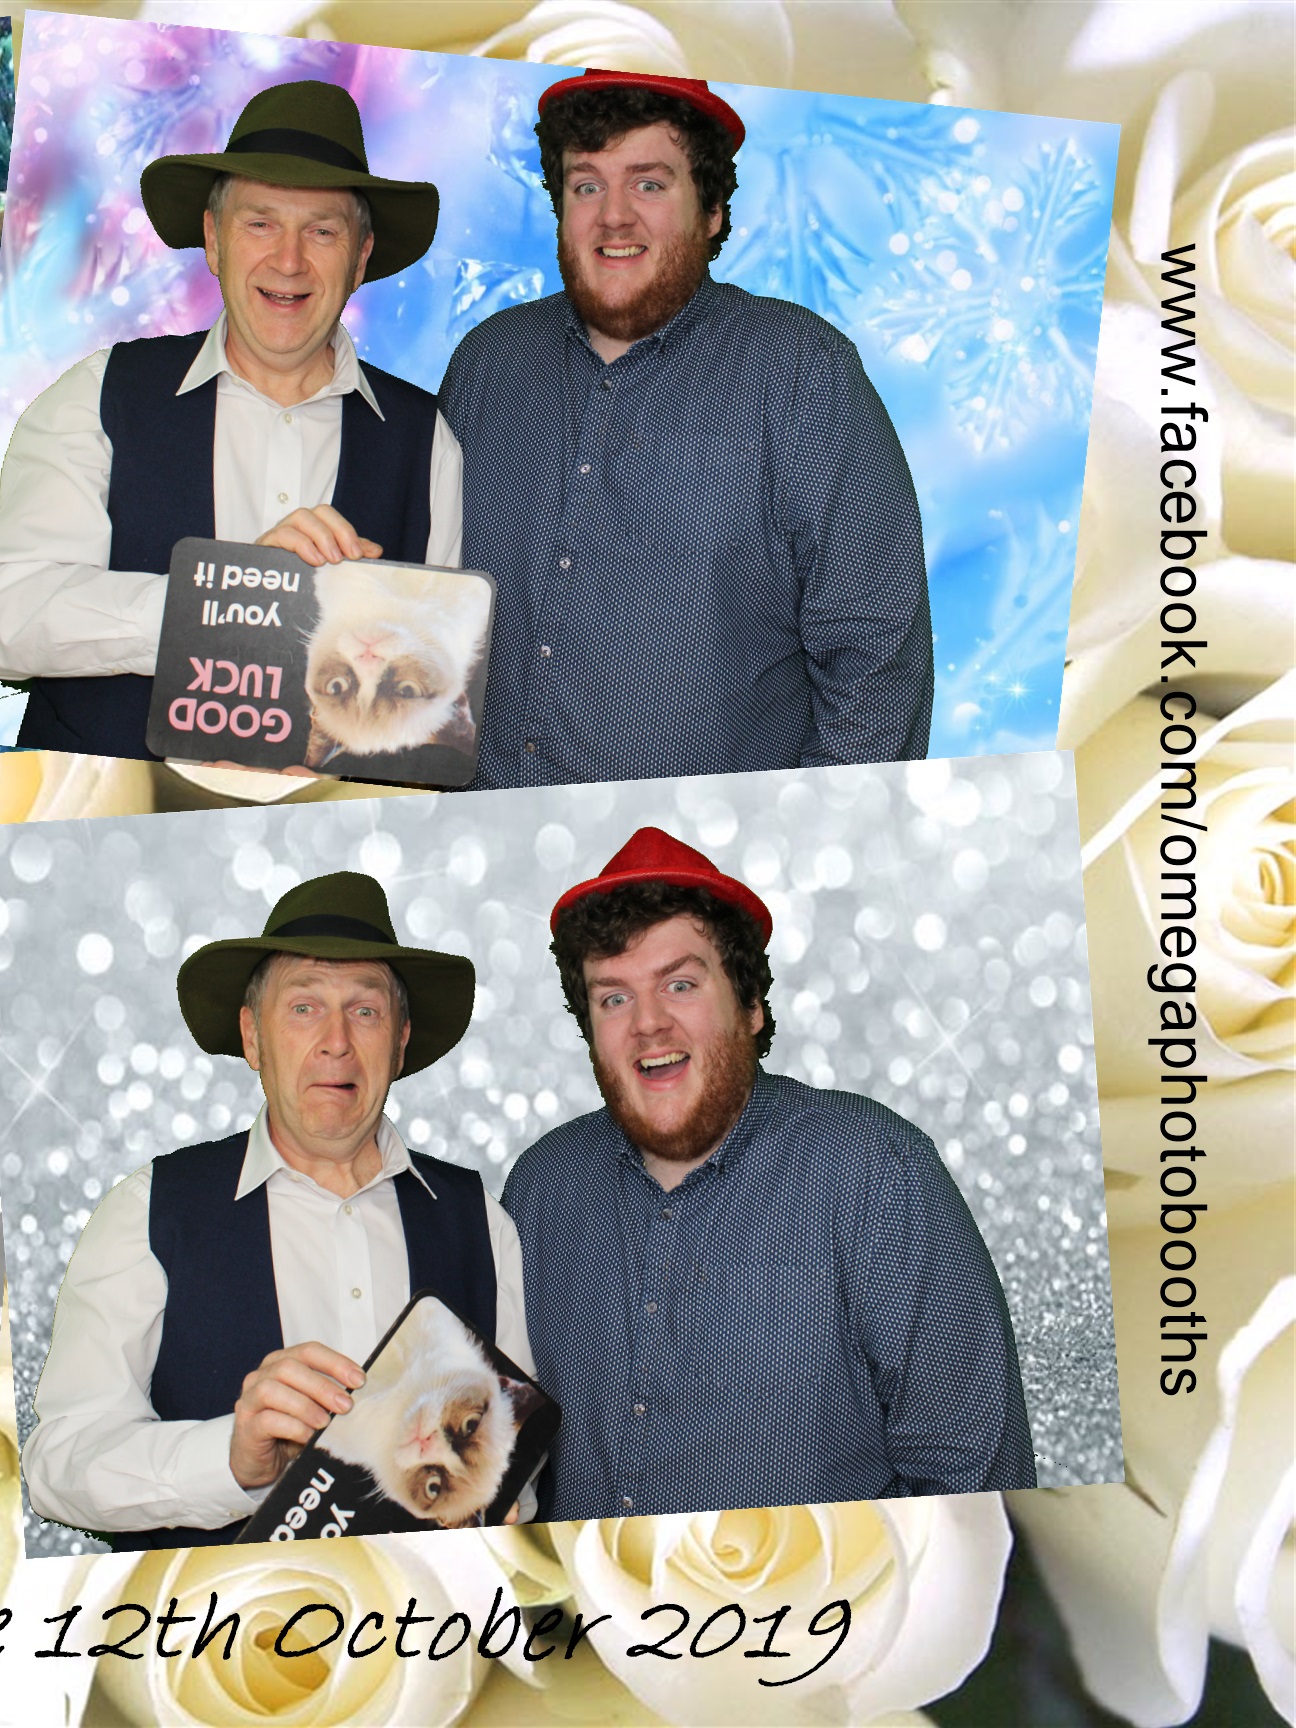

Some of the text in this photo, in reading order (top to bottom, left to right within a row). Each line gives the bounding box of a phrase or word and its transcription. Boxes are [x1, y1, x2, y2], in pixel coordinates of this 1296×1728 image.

[193, 561, 301, 593] need it
[185, 656, 283, 700] LUCK
[168, 694, 292, 743] GOOD
